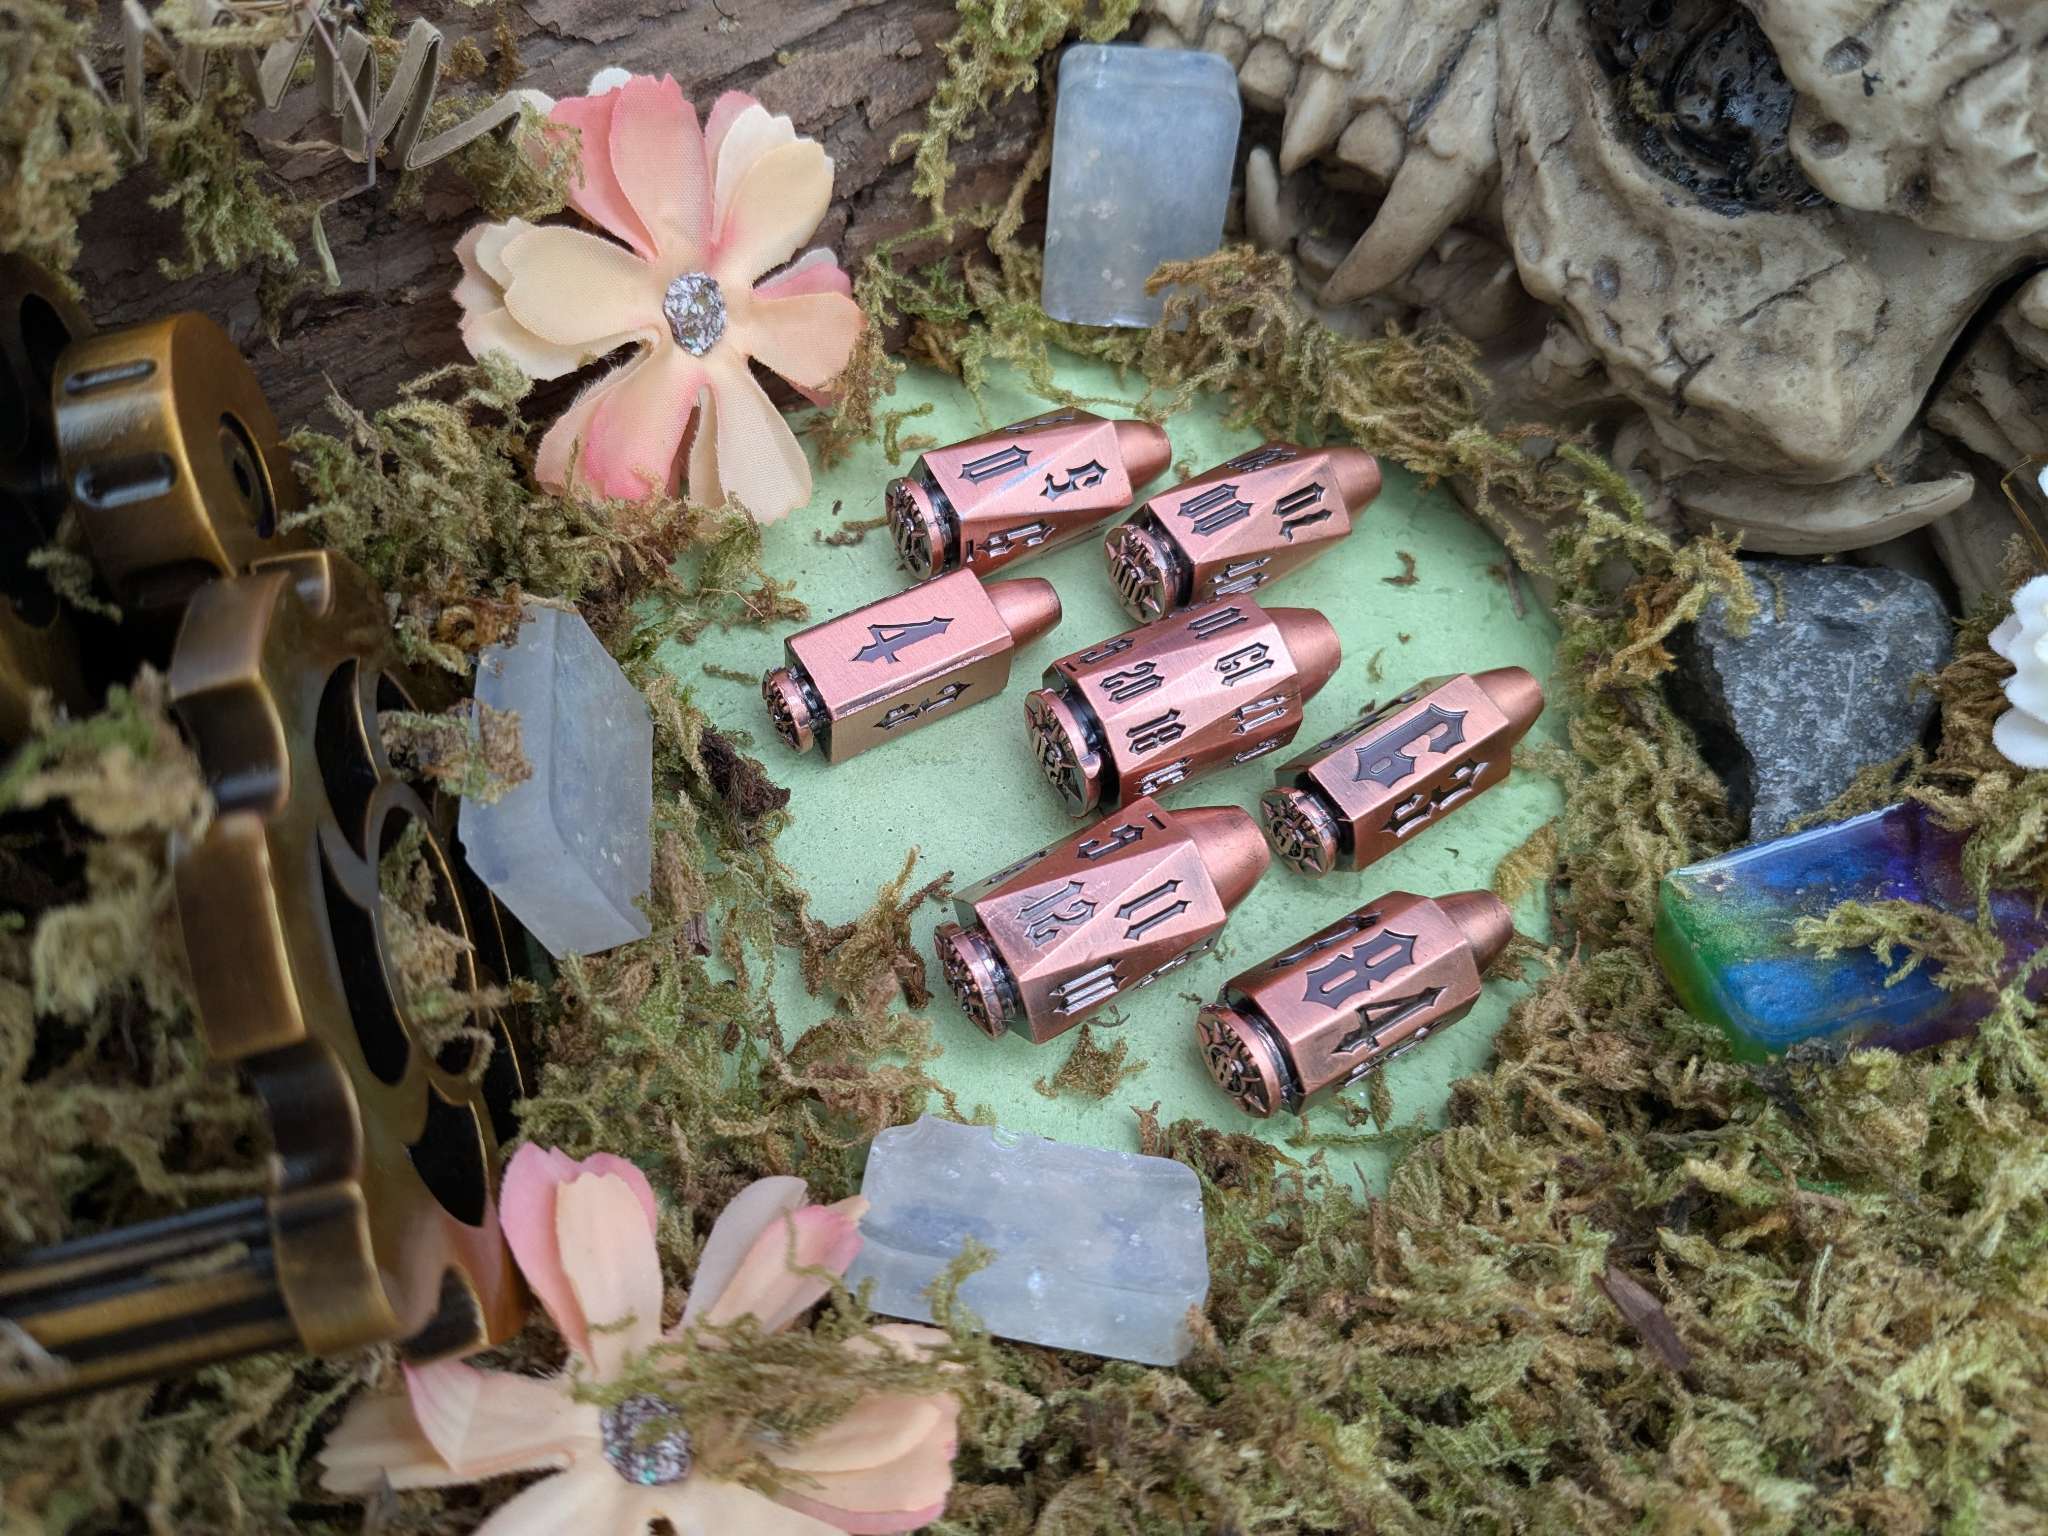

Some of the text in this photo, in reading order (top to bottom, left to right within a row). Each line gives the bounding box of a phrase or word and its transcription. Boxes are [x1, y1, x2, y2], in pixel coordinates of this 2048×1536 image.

[849, 616, 955, 664] 4
[1100, 661, 1165, 704] 20
[1126, 708, 1187, 755] 18
[1352, 702, 1469, 789] 6
[1015, 879, 1097, 948] 12
[1302, 927, 1419, 1009] 8
[1330, 985, 1448, 1054] 4
